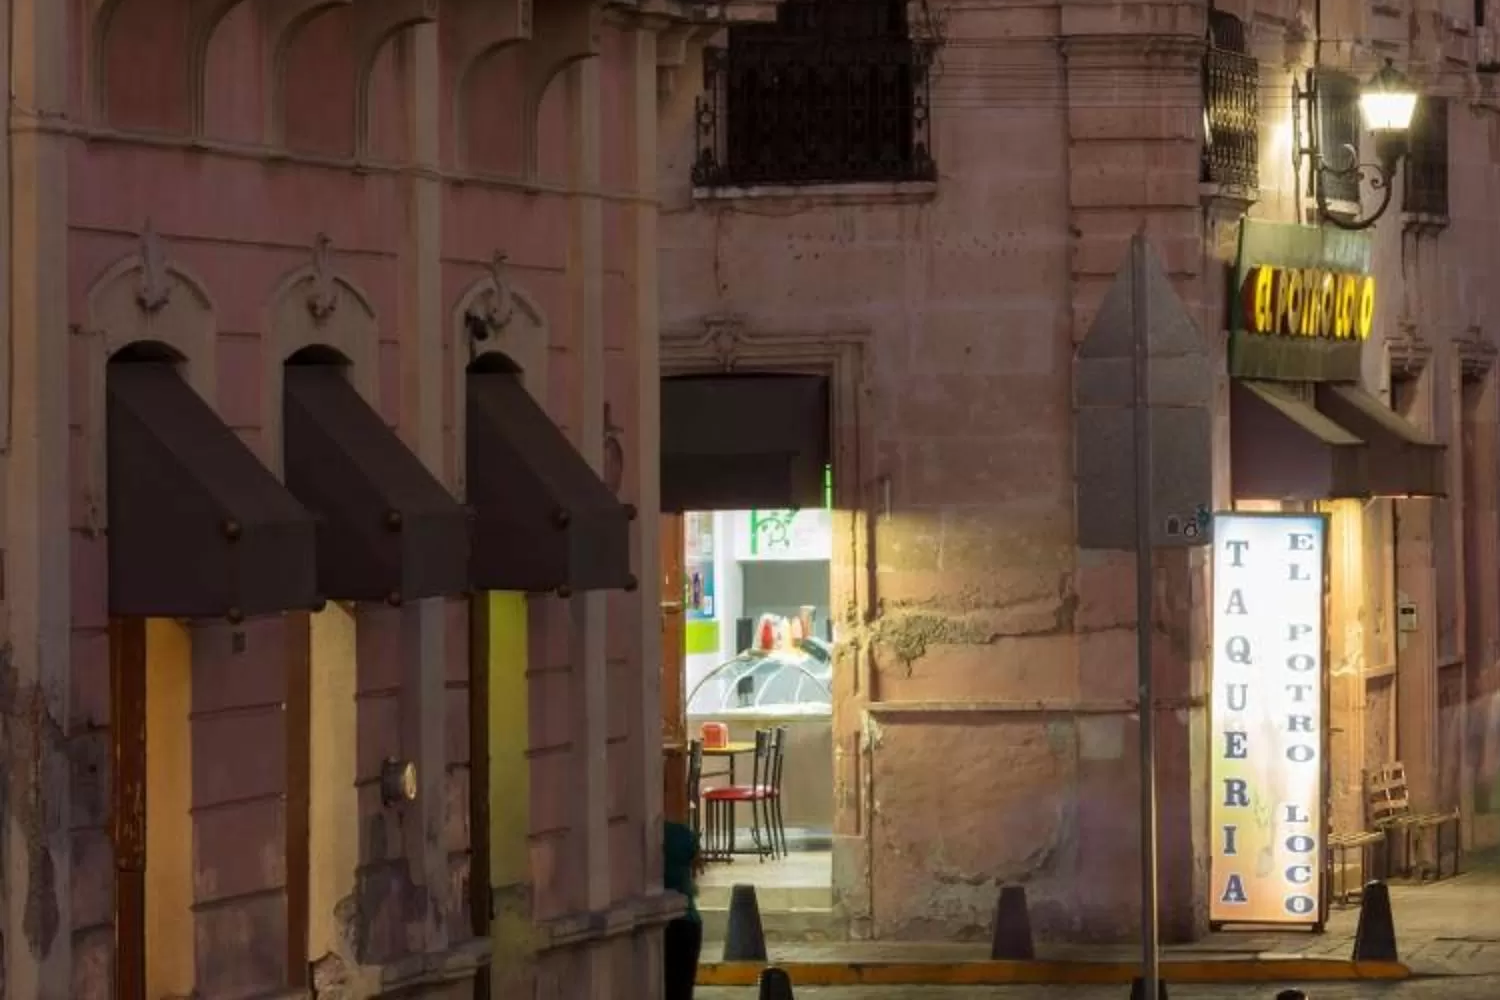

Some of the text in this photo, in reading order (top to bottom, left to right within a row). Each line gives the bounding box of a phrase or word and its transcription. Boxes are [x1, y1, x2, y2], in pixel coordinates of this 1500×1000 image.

[1255, 264, 1274, 333] EL
[1276, 267, 1335, 338] POTRO
[1221, 538, 1253, 904] TAQUERIA
[1284, 532, 1316, 915] EL POTRO LOCO
